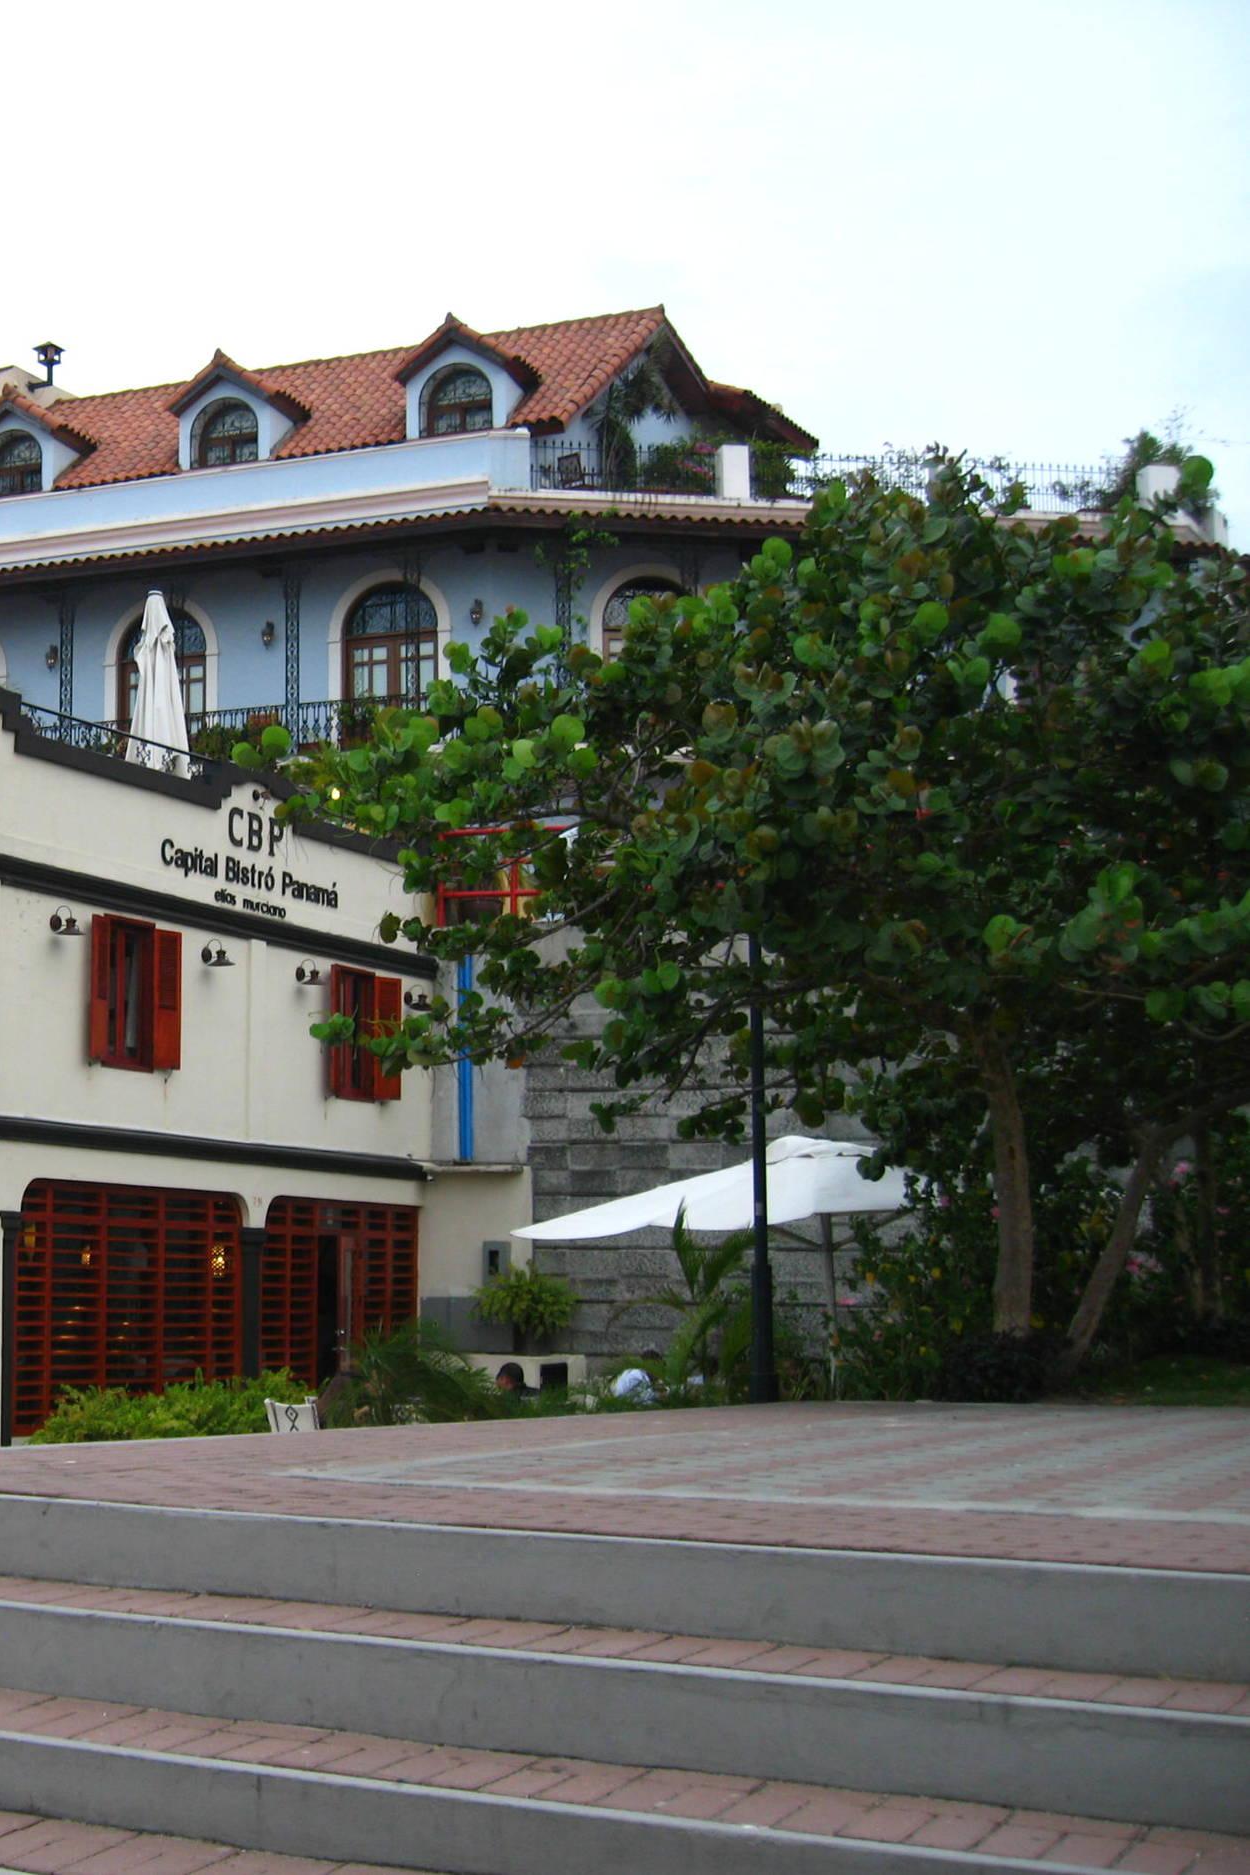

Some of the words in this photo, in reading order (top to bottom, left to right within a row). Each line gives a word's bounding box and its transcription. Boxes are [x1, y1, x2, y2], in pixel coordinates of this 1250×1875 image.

[227, 807, 284, 857] CBP
[161, 838, 218, 878] Capital
[225, 856, 276, 892] Bistró
[282, 871, 339, 909] Panamá
[242, 897, 287, 919] murciano
